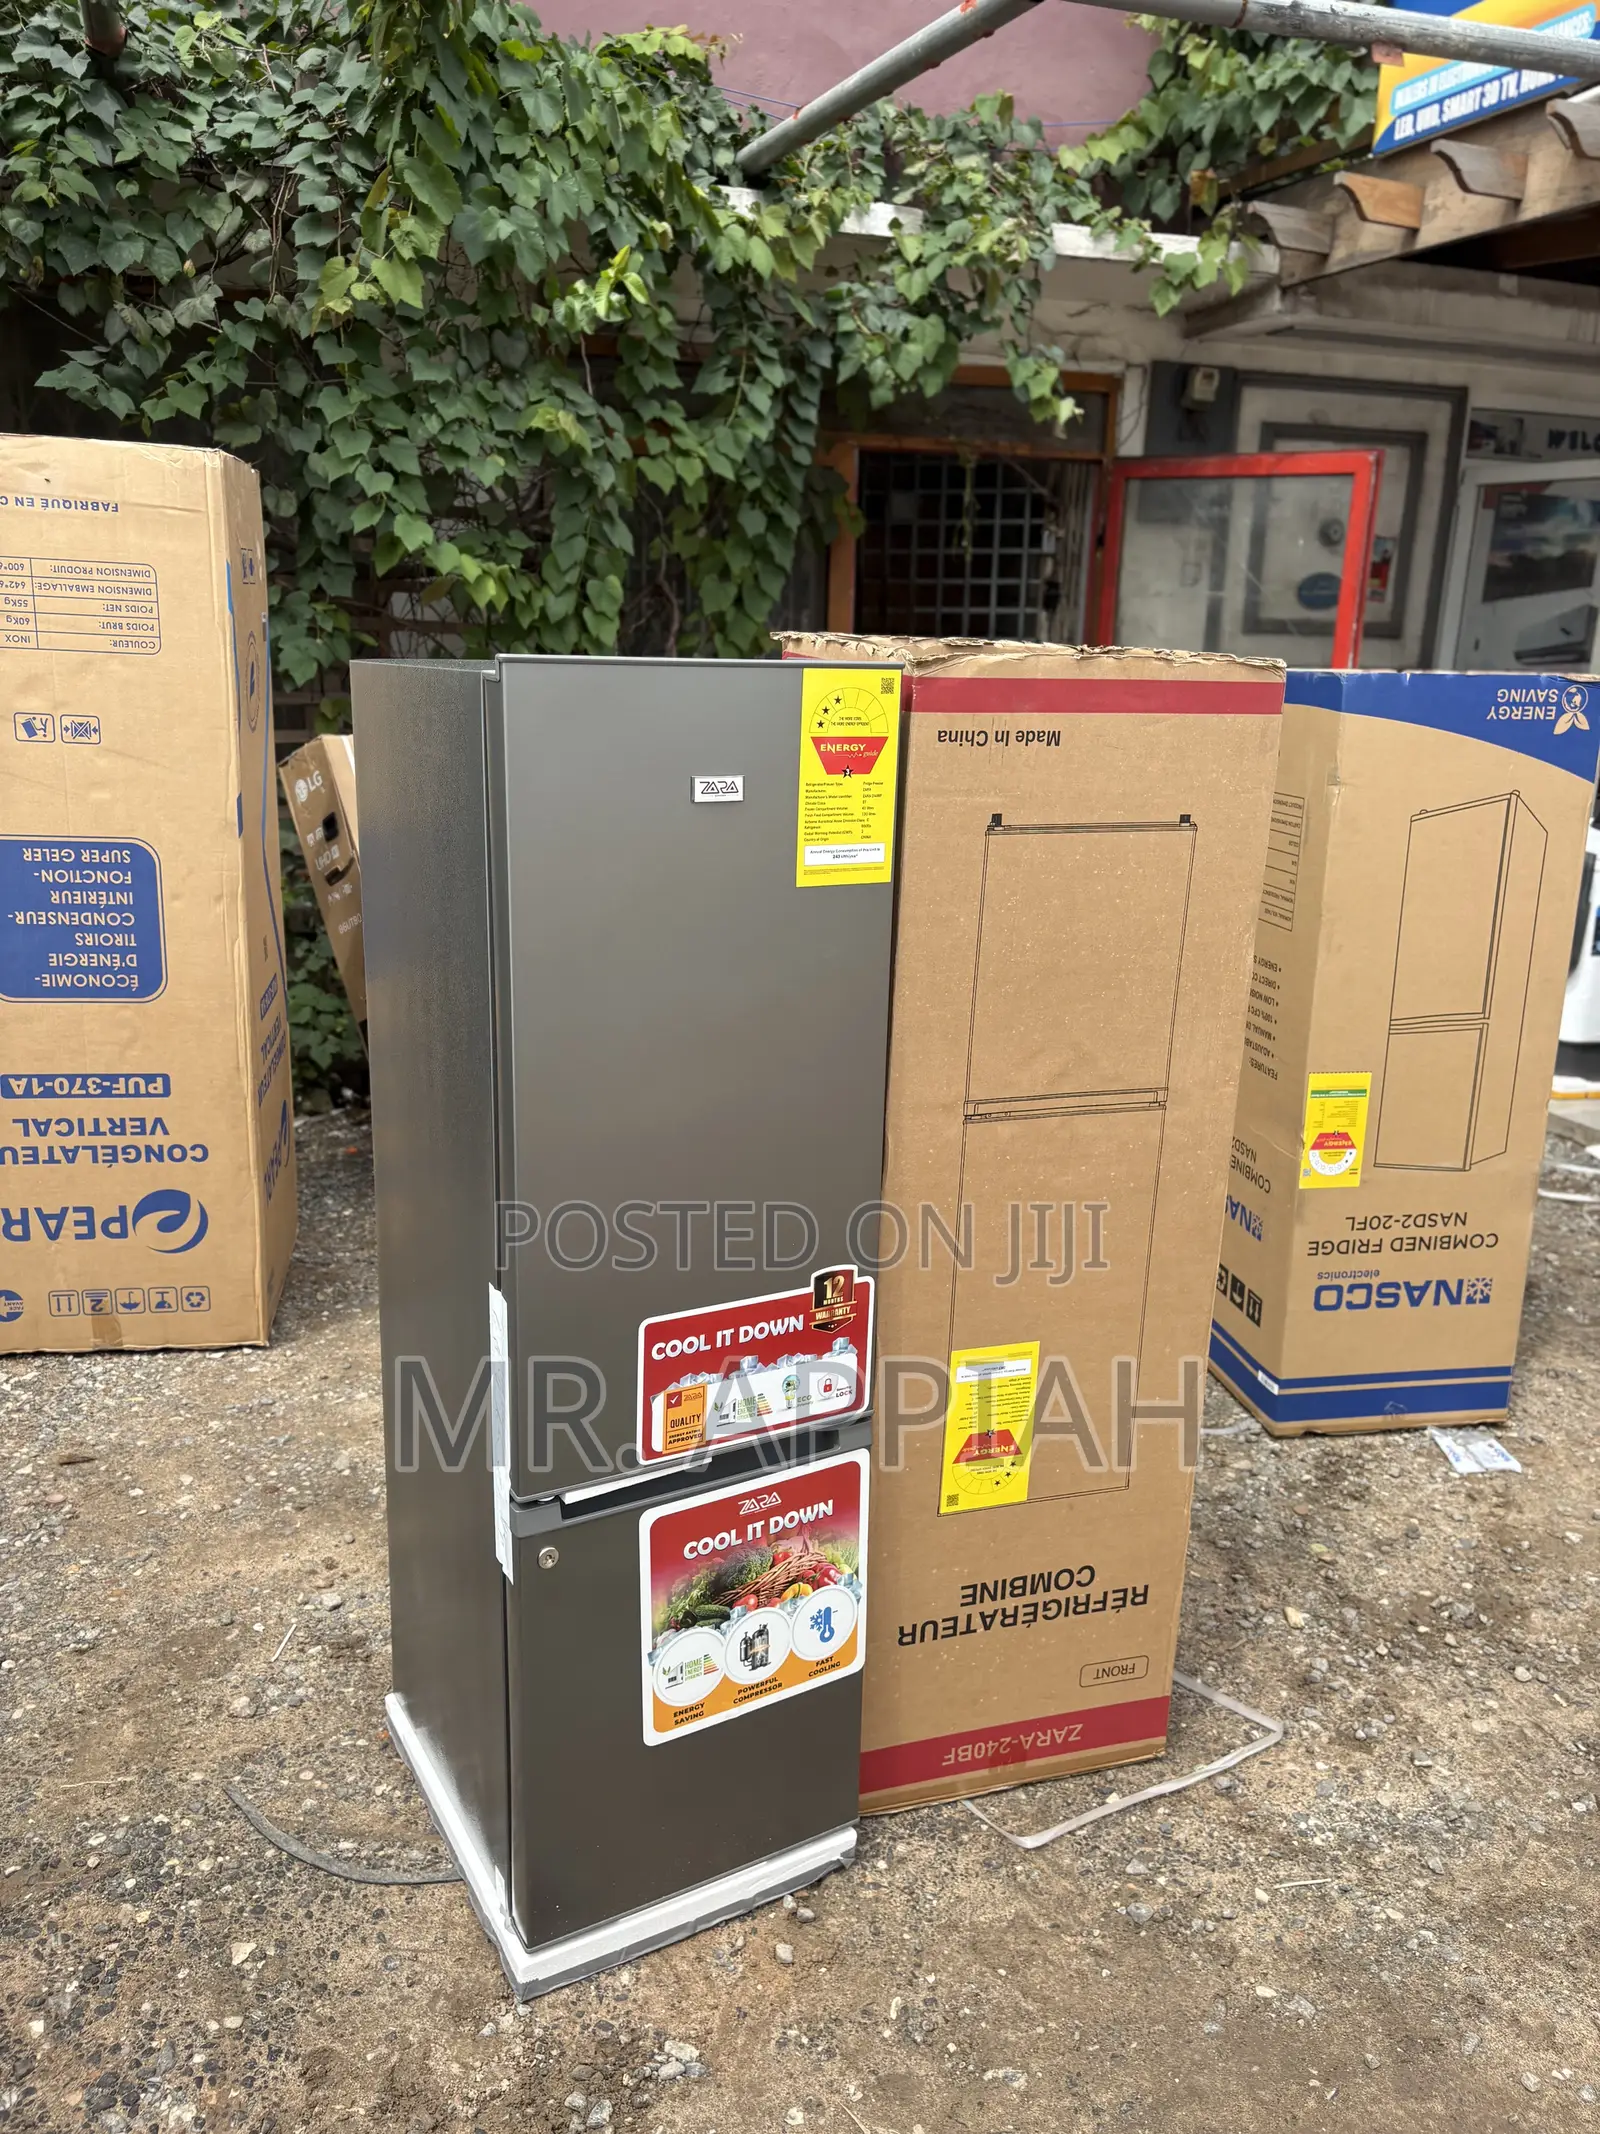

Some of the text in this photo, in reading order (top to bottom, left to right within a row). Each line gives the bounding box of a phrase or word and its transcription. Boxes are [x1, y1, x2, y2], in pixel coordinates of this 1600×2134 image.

[1442, 86, 1482, 122] SMART
[15, 496, 35, 507] EN
[41, 497, 119, 513] FABRIQUÉ
[50, 563, 151, 578] DIMENSION PRODUIT:
[34, 582, 152, 596] DIMENSION EMBALLAGE:
[4, 597, 29, 608] 55Kg
[102, 603, 153, 614] POIDS NET:
[5, 615, 31, 626] 60Kg
[98, 620, 155, 632] POIDS BRUT:
[4, 634, 31, 644] INOX
[109, 639, 156, 650] COULEUR:
[1497, 688, 1559, 703] SAVING
[1486, 705, 1557, 720] ENERGY
[937, 730, 1061, 747] Made In China
[820, 742, 866, 754] ENERGY
[307, 770, 323, 792] LG
[699, 780, 739, 795] ZARA
[22, 848, 132, 863] SUPER GELER
[315, 850, 332, 871] UHD
[34, 869, 132, 884] FONCTION-
[50, 890, 134, 908] INTÉRIEUR
[7, 911, 135, 927] CONDENSEUR-
[75, 932, 137, 946] TIROIRS
[48, 953, 137, 971] D'ÉNERGIE
[1258, 957, 1278, 973] ENERGY
[34, 973, 139, 992] ÉCONOMIE-
[1259, 975, 1277, 990] DIRECT
[1263, 995, 1275, 1007] LOW
[1251, 1006, 1260, 1018] CFC
[1252, 1023, 1272, 1041] MANUAL
[1249, 1056, 1278, 1081] FEATURES:
[7, 1076, 164, 1095] PUF-370-1A
[12, 1117, 170, 1137] VERTICAL
[0, 1144, 209, 1169] CONGÉLATEU
[1230, 1154, 1271, 1194] COMBINE
[1, 1204, 129, 1242] PEAR
[1345, 1212, 1468, 1232] NASD2-20FL
[1307, 1233, 1499, 1257] COMBINED FRIDGE
[1317, 1269, 1380, 1281] electronics
[823, 1275, 845, 1299] 12
[1313, 1278, 1464, 1312] NASCO
[815, 1305, 851, 1320] WARRANTY
[651, 1314, 804, 1361] COOL IT DOWN
[797, 1394, 812, 1403] ECO
[835, 1389, 853, 1398] LOCK
[737, 1396, 756, 1409] HOME
[670, 1413, 701, 1428] QUALITY
[667, 1432, 703, 1445] APPROVED
[973, 1444, 1015, 1457] ENERGY
[737, 1491, 782, 1515] ZARA
[683, 1499, 834, 1560] COOL IT DOWN
[960, 1565, 1096, 1607] COMBINE
[897, 1584, 1149, 1647] RÉFRIGÉRATEUR
[685, 1656, 703, 1670] HOME
[808, 1661, 841, 1678] COOLING
[815, 1656, 834, 1667] FAST
[685, 1665, 703, 1676] ENERGY
[1093, 1662, 1136, 1681] FRONT
[733, 1682, 783, 1704] COMPRESSOR
[738, 1676, 779, 1695] POWERFUL
[673, 1702, 705, 1718] ENERGY
[674, 1710, 705, 1726] SAVING
[941, 1723, 1084, 1767] ZARA-240BF
